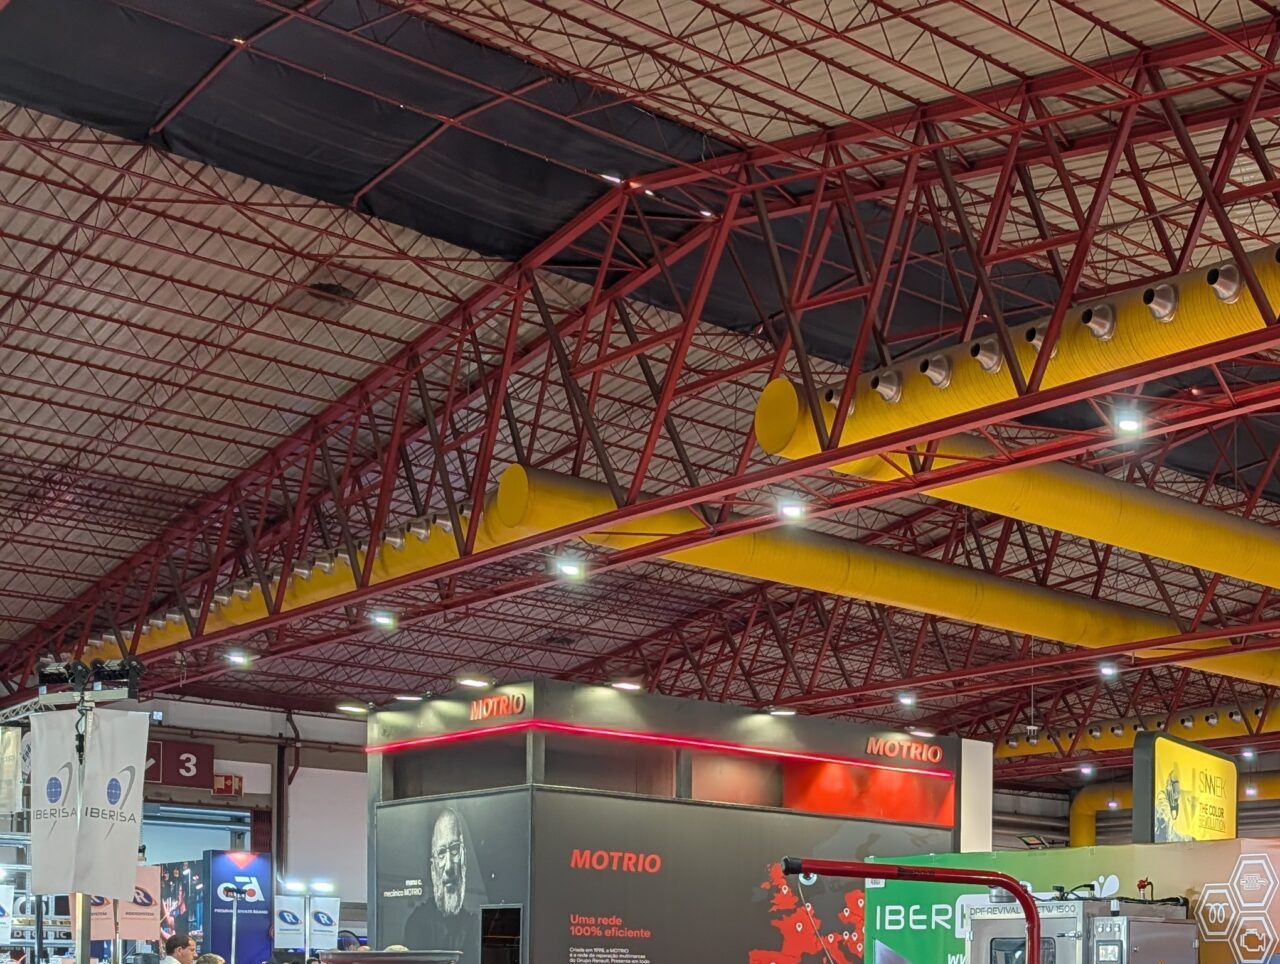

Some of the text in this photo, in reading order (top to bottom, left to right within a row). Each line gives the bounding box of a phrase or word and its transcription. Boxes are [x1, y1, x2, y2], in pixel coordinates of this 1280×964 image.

[470, 693, 525, 720] MOTRIO
[866, 736, 943, 764] MOTRIO
[179, 753, 197, 777] 3
[33, 807, 77, 820] IBERISA
[85, 807, 136, 823] IBERISA
[570, 849, 662, 873] MOTRIO
[570, 914, 622, 925] Uma rede
[570, 926, 651, 938] 100% eficiente
